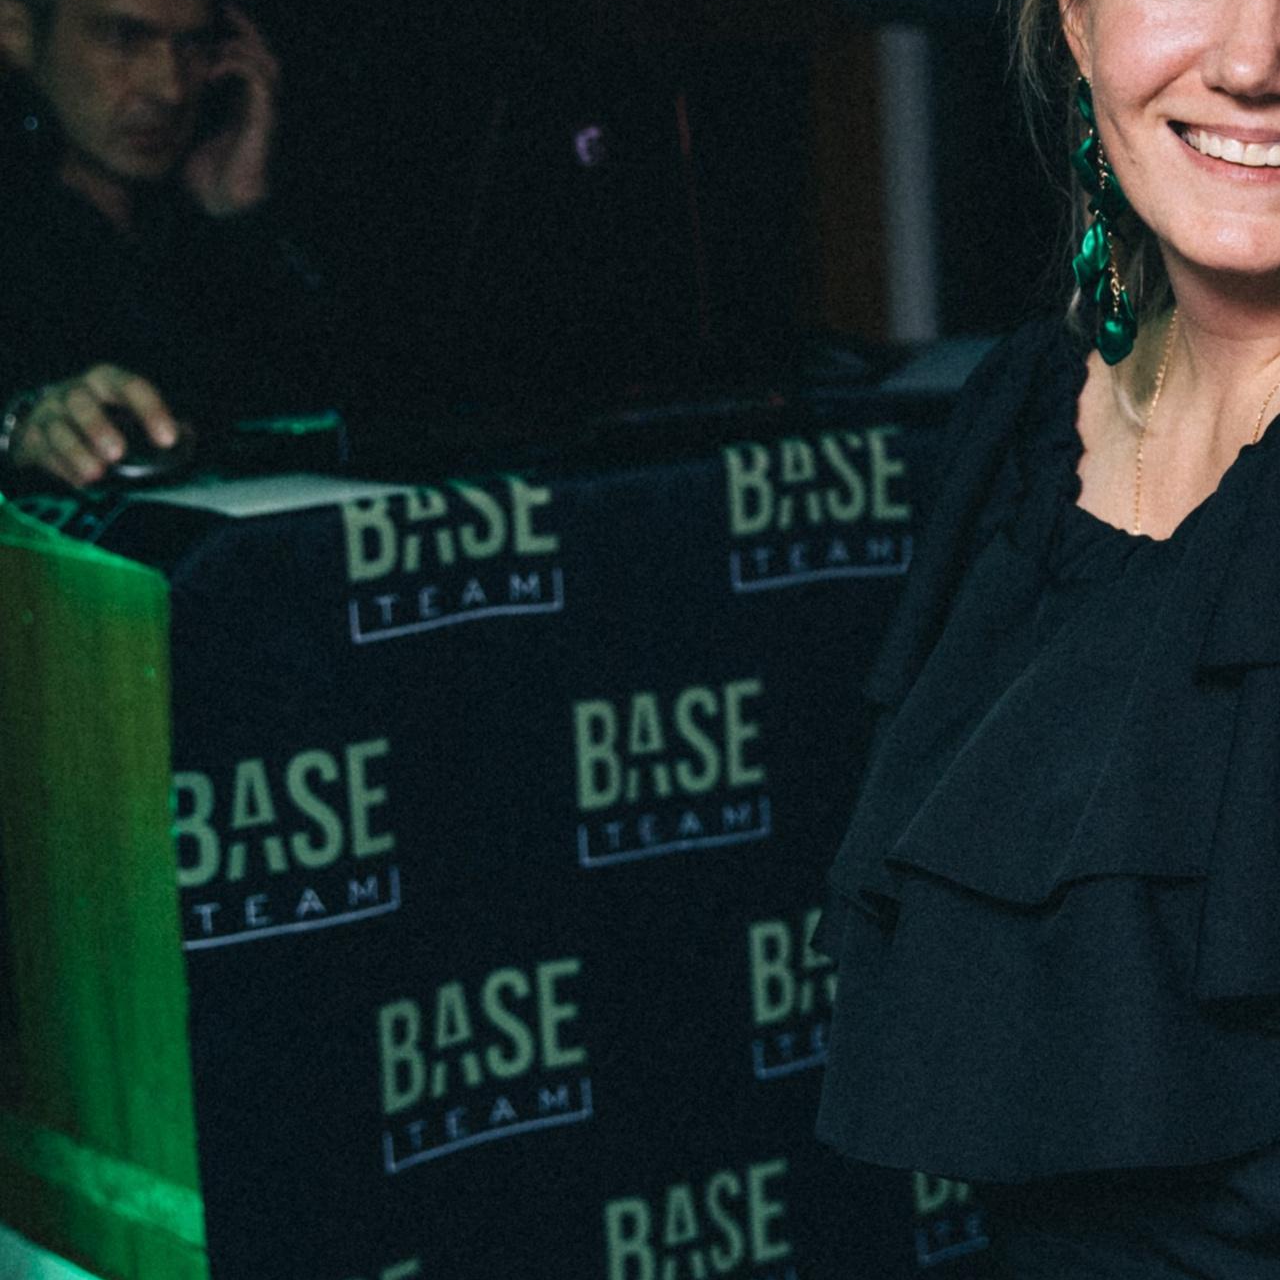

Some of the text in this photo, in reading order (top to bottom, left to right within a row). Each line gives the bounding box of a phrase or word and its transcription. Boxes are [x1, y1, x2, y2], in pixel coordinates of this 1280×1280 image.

[340, 473, 560, 582] BASE
[722, 425, 912, 537] BASE
[375, 571, 541, 623] TEAM
[755, 535, 894, 573] TEAM
[573, 677, 766, 812] BASE
[170, 736, 396, 887] BASE
[605, 801, 752, 849] TEAM
[192, 874, 379, 935] TEAM
[749, 908, 839, 1025] BA
[378, 956, 587, 1116] BASE
[409, 1084, 570, 1149] TEAM
